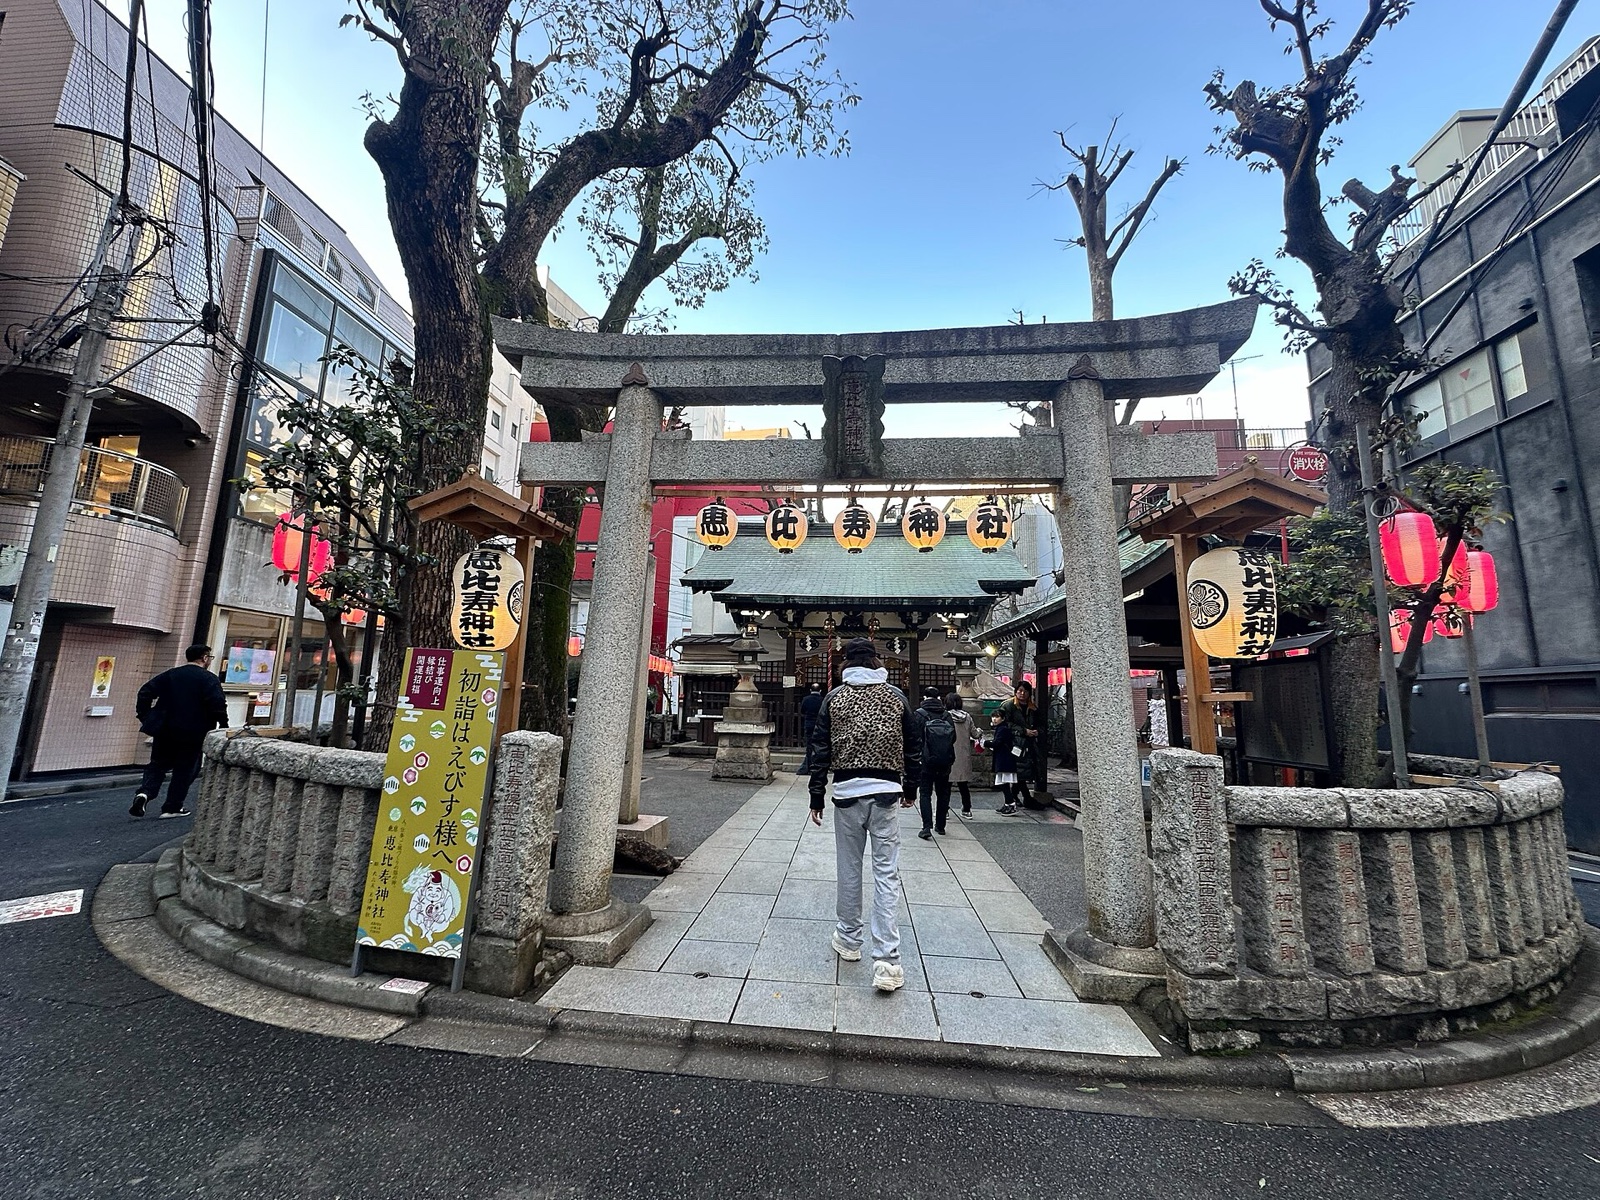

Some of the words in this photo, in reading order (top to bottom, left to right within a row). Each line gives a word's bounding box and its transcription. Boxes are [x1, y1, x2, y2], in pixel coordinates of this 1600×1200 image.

[1293, 457, 1326, 471] 消火栓
[459, 551, 501, 648] 恵比寿神社
[424, 656, 437, 684] 縁結び
[430, 656, 447, 706] 仕事運向上
[431, 668, 481, 865] 初詣はえびす様へ
[372, 835, 396, 919] 恵比寿神社
[1272, 841, 1299, 964] 山口新三郎
